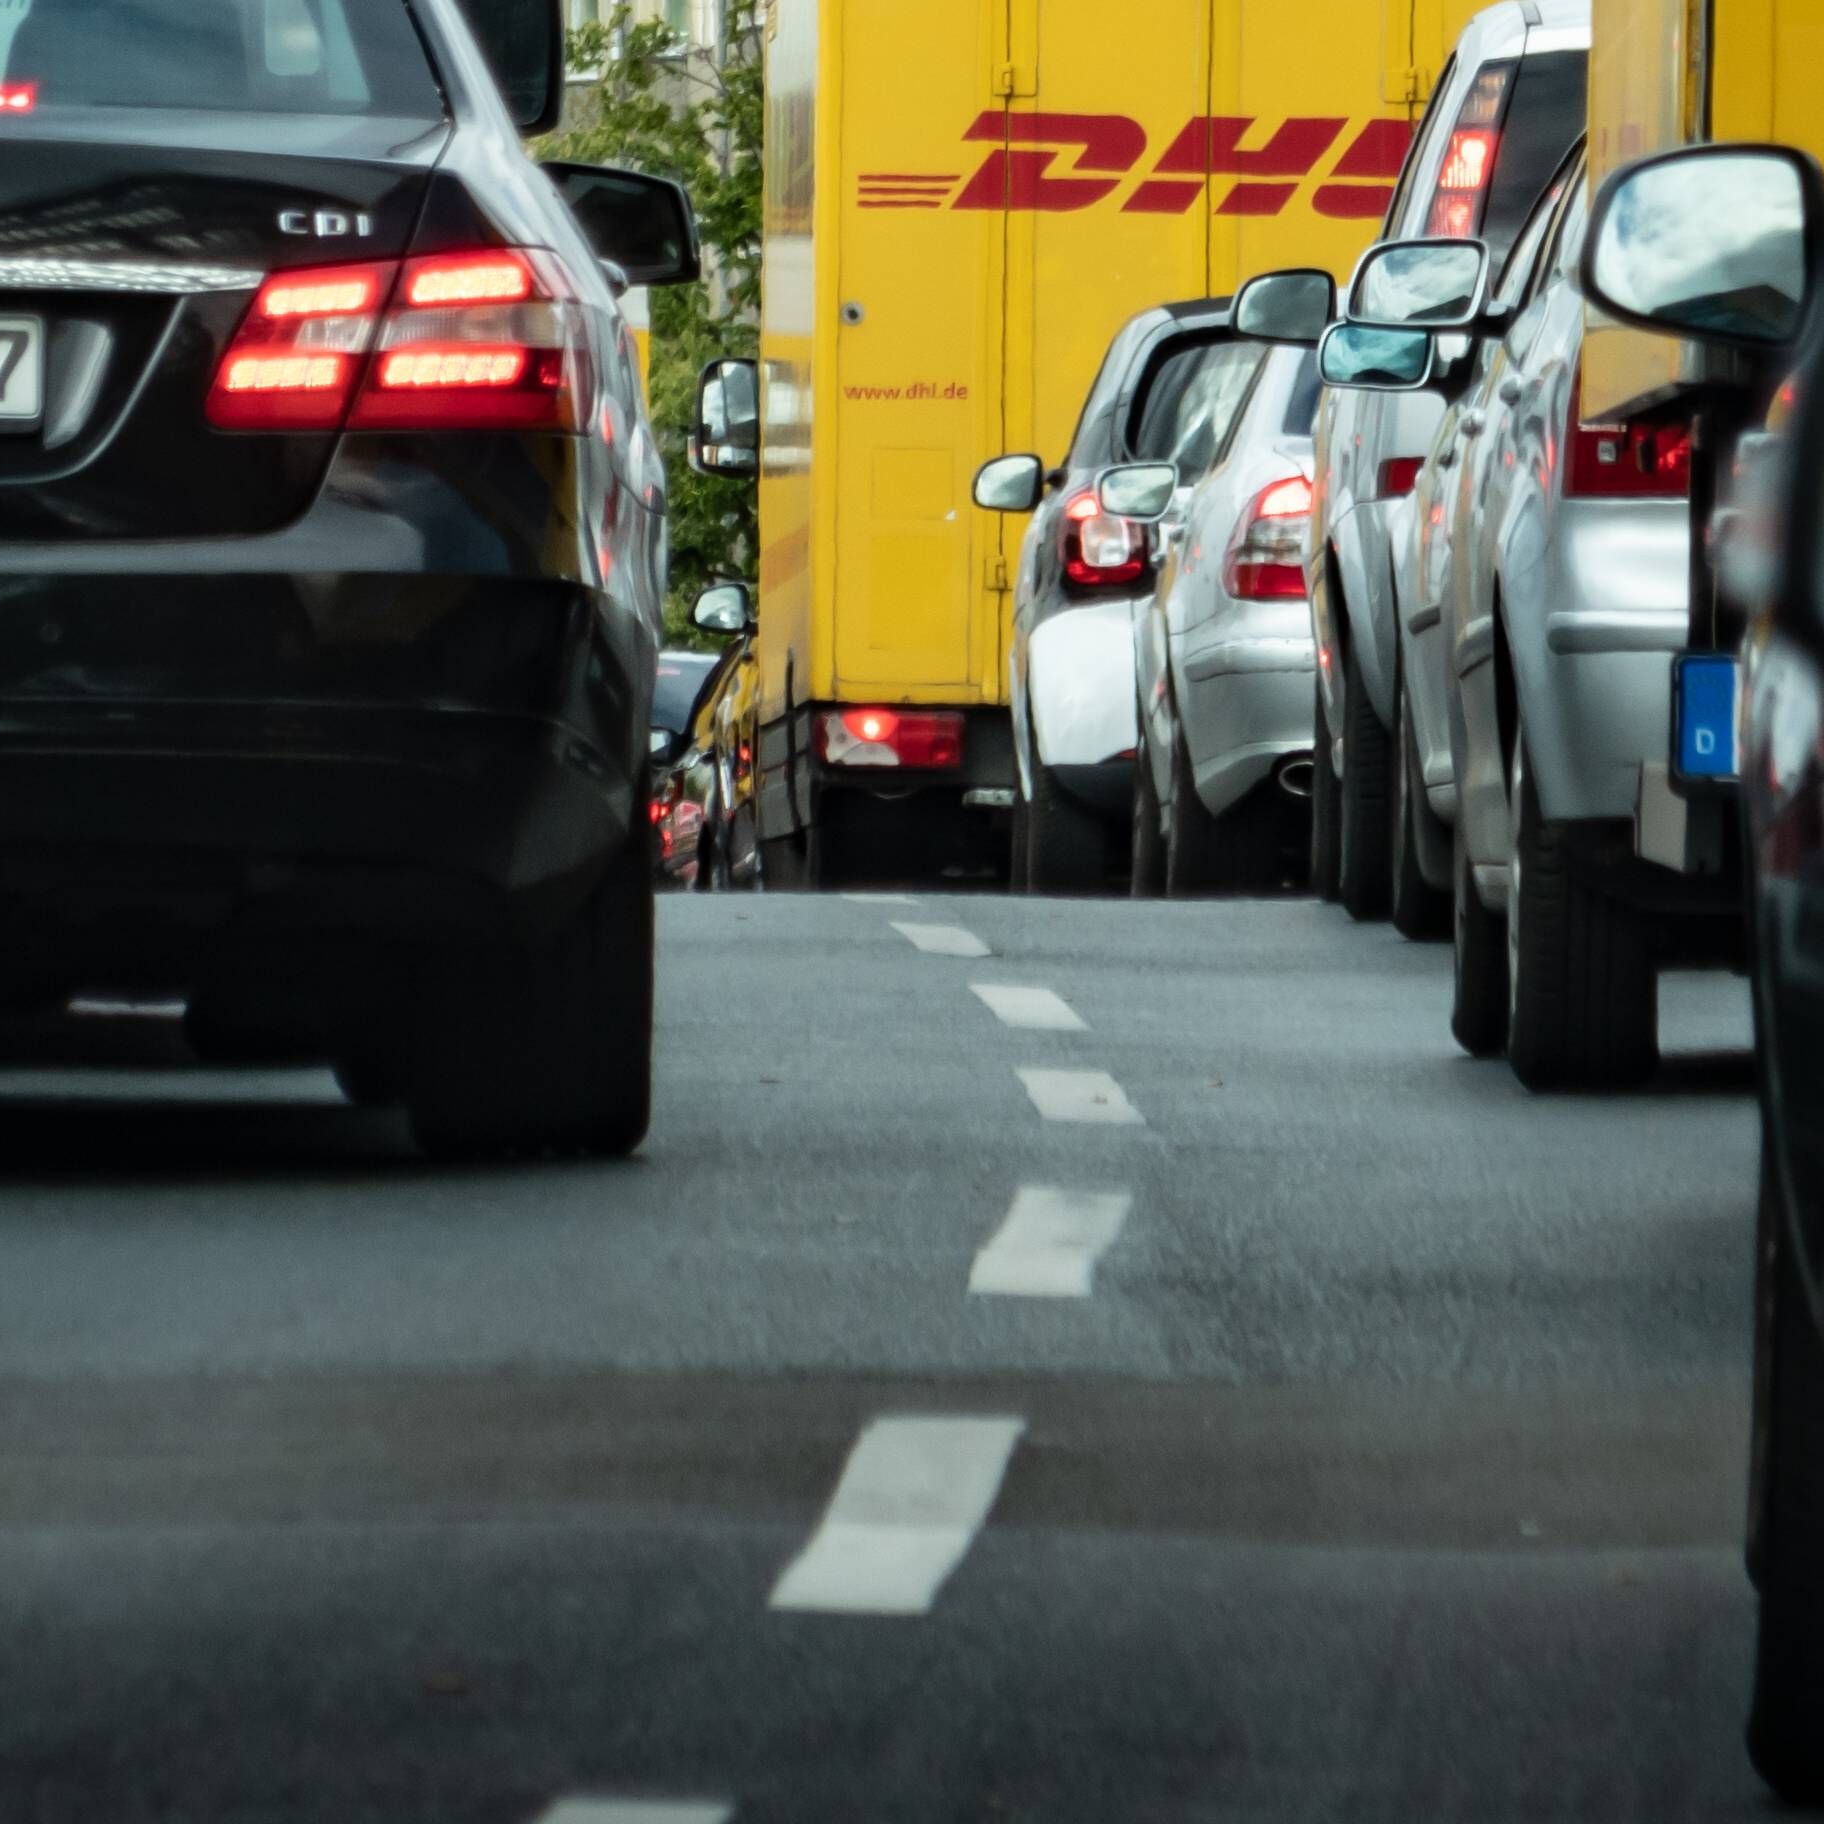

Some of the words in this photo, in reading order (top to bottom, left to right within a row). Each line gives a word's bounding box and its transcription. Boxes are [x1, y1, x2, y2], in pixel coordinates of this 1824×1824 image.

[278, 211, 371, 237] CDI
[843, 382, 968, 399] www.dhl.de
[1695, 727, 1716, 755] D
